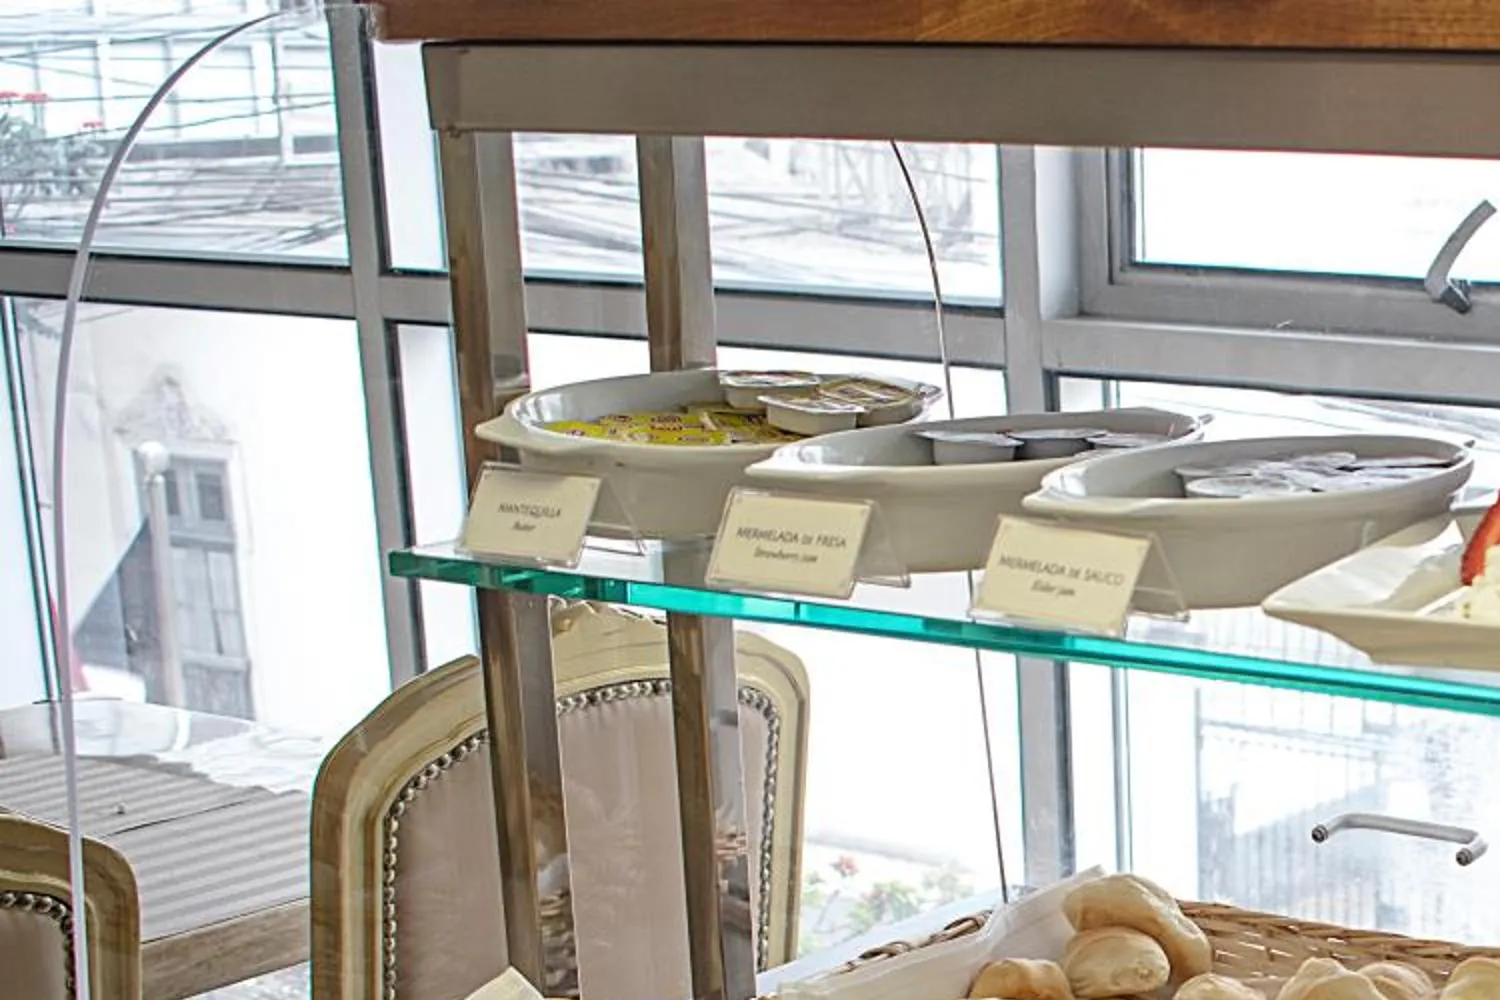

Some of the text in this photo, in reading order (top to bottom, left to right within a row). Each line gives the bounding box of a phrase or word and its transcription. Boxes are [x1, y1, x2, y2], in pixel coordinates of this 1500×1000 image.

[498, 503, 560, 518] MANTEQUILLA
[737, 527, 798, 544] MERMELADA
[816, 534, 847, 548] FRESA
[999, 554, 1065, 575] MERMELADA
